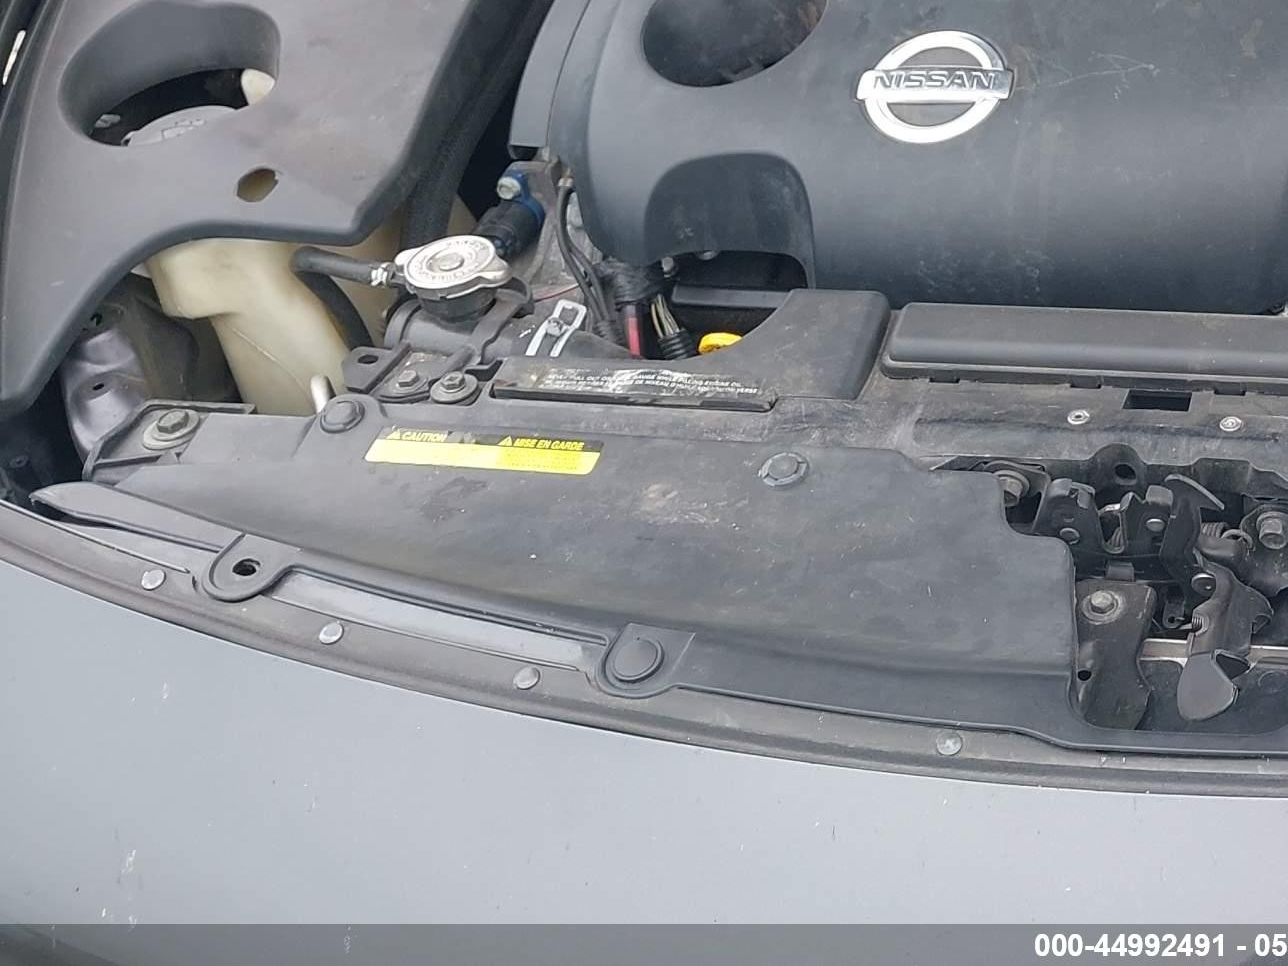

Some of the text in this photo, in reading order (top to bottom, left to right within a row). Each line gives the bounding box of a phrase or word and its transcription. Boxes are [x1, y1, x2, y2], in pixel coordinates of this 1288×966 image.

[873, 70, 997, 90] NISSAN
[402, 431, 447, 442] CAUTION
[513, 438, 584, 451] MISE EN GARDE
